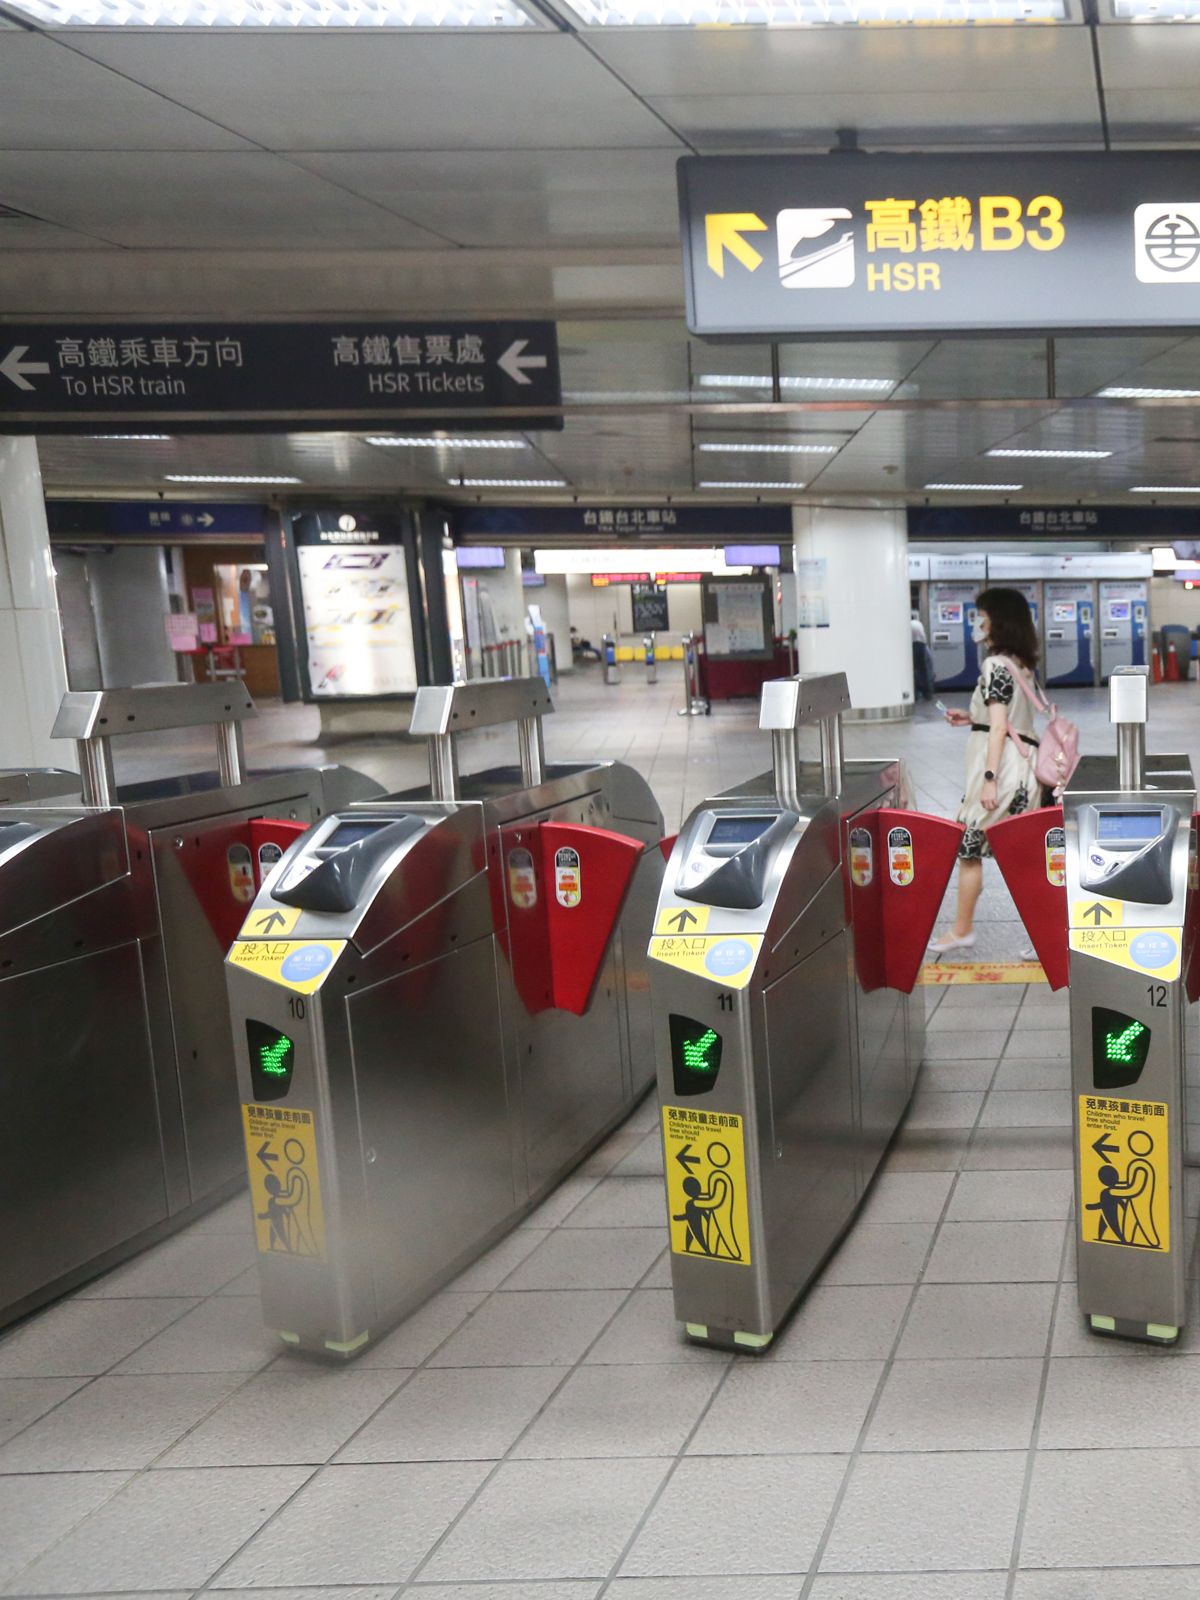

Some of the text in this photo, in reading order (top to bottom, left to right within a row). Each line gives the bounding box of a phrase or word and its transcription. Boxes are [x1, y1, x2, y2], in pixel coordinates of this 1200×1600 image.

[864, 195, 1066, 253] 高鐵B3
[866, 262, 941, 292] HSR
[55, 336, 244, 368] 高鐵乘車方向
[331, 333, 486, 366] 高鐵售票處
[61, 375, 186, 395] To HSR train
[369, 371, 485, 393] HSR Tickets
[662, 938, 706, 949] 投入口
[1081, 930, 1126, 942] 投入口
[240, 943, 290, 955] 投入口
[718, 993, 733, 1011] 11
[1147, 985, 1167, 1007] 12
[289, 998, 305, 1019] 10
[1086, 1098, 1165, 1116] 免票孩童走前面
[1087, 1110, 1112, 1118] Children
